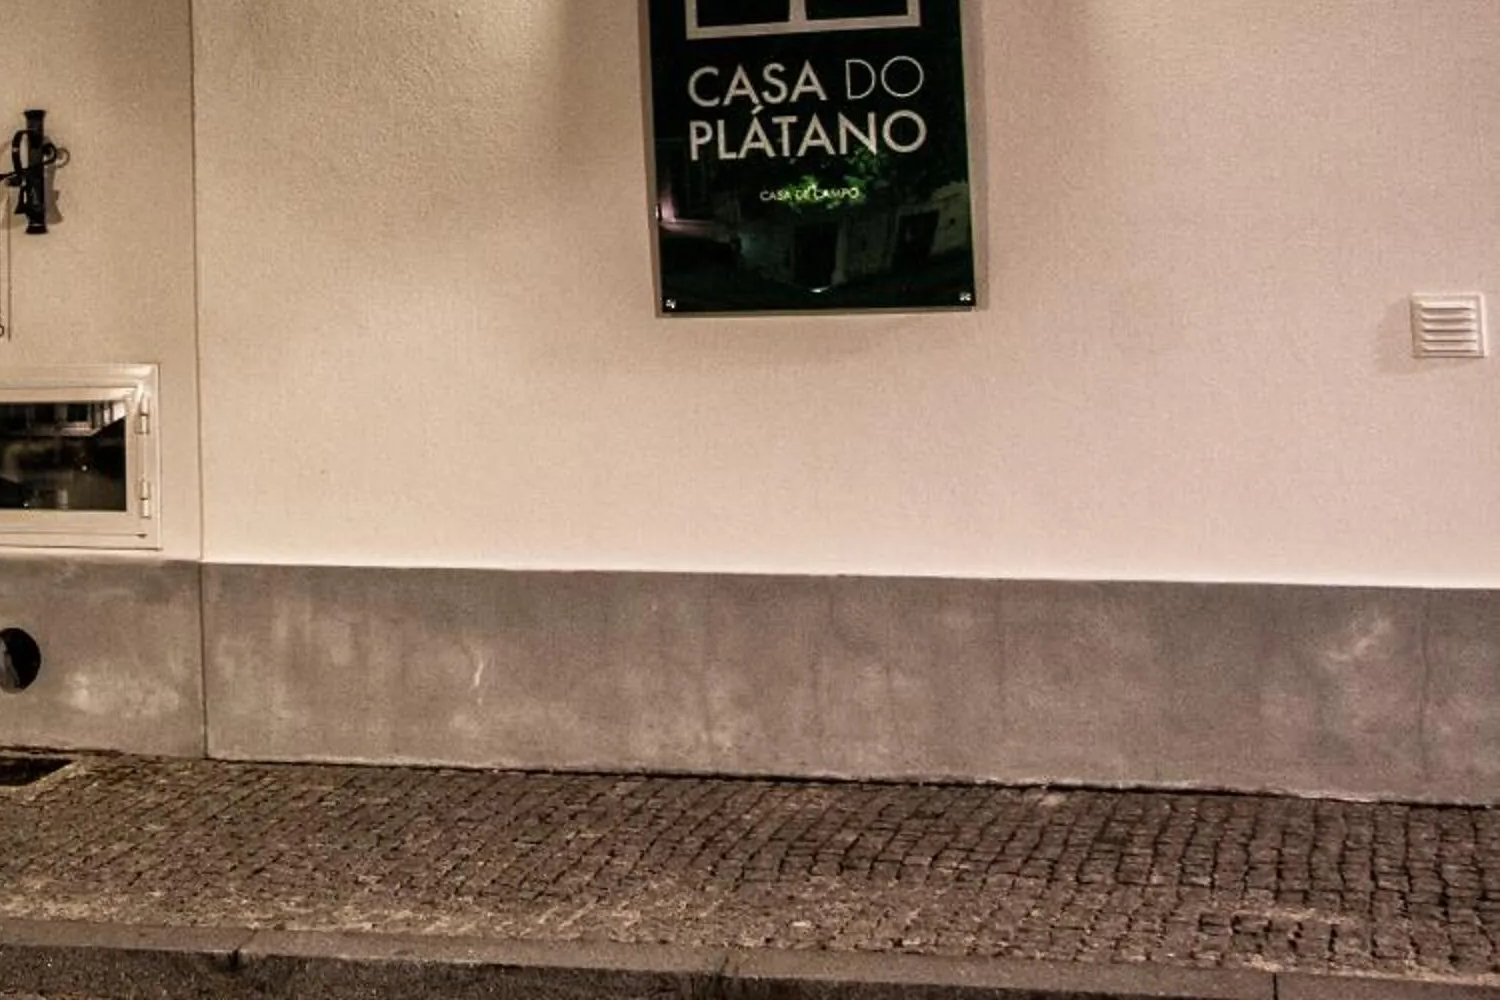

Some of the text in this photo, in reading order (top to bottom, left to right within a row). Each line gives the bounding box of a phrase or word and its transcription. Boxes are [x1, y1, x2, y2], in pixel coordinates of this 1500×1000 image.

[687, 55, 925, 107] CASA DO
[760, 189, 792, 201] CASA
[814, 187, 860, 201] CAMPO
